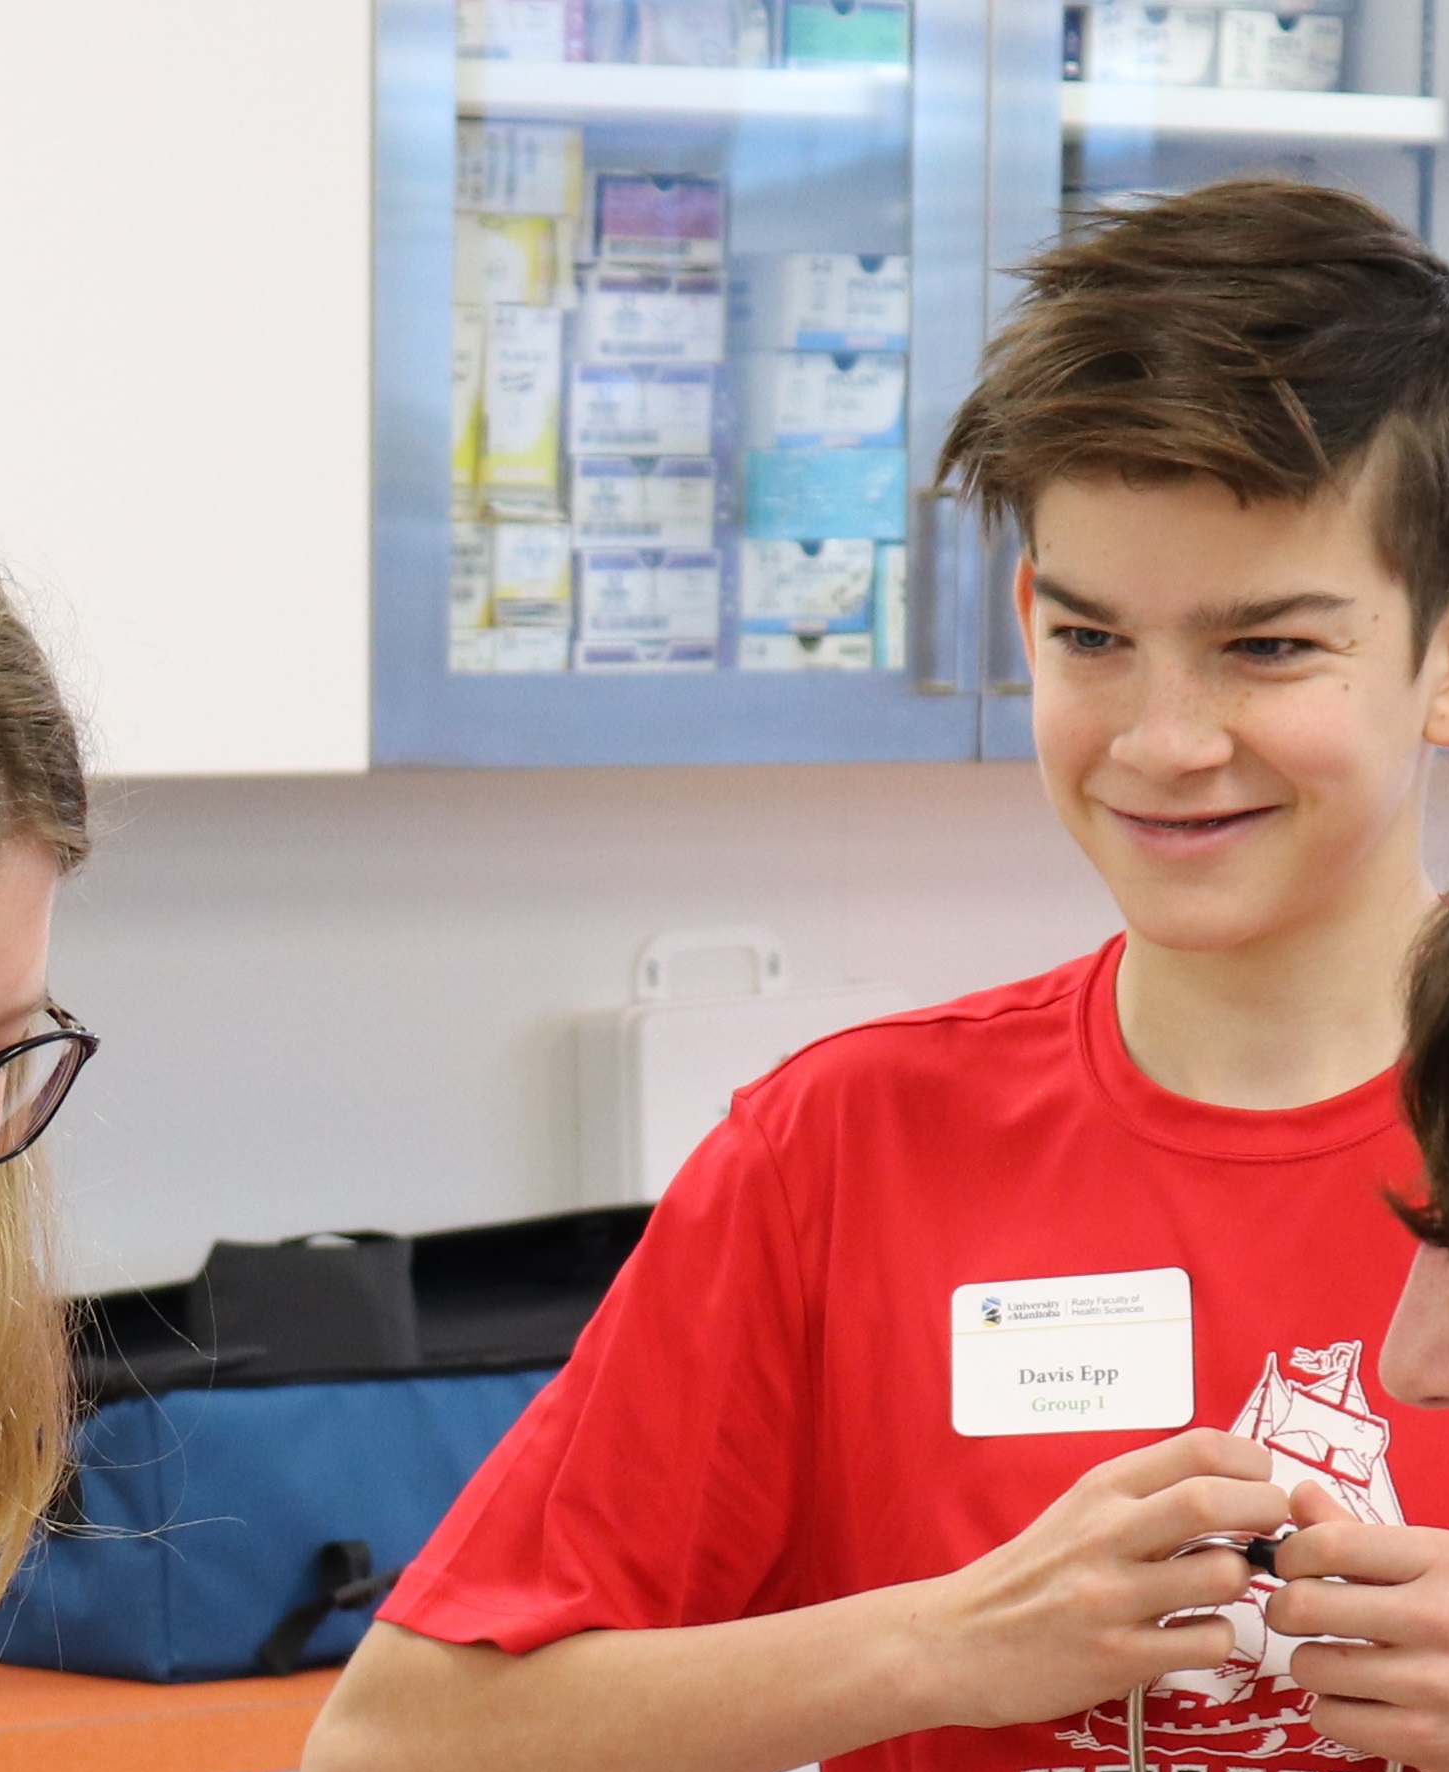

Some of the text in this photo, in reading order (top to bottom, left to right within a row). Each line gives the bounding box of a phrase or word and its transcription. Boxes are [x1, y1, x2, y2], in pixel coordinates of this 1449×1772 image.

[1007, 1299, 1060, 1312] University
[1072, 1293, 1141, 1307] Rady Faculty of
[1072, 1304, 1145, 1316] Health Sciences
[1018, 1365, 1120, 1386] Davis Epp
[1031, 1395, 1106, 1415] Group 1
